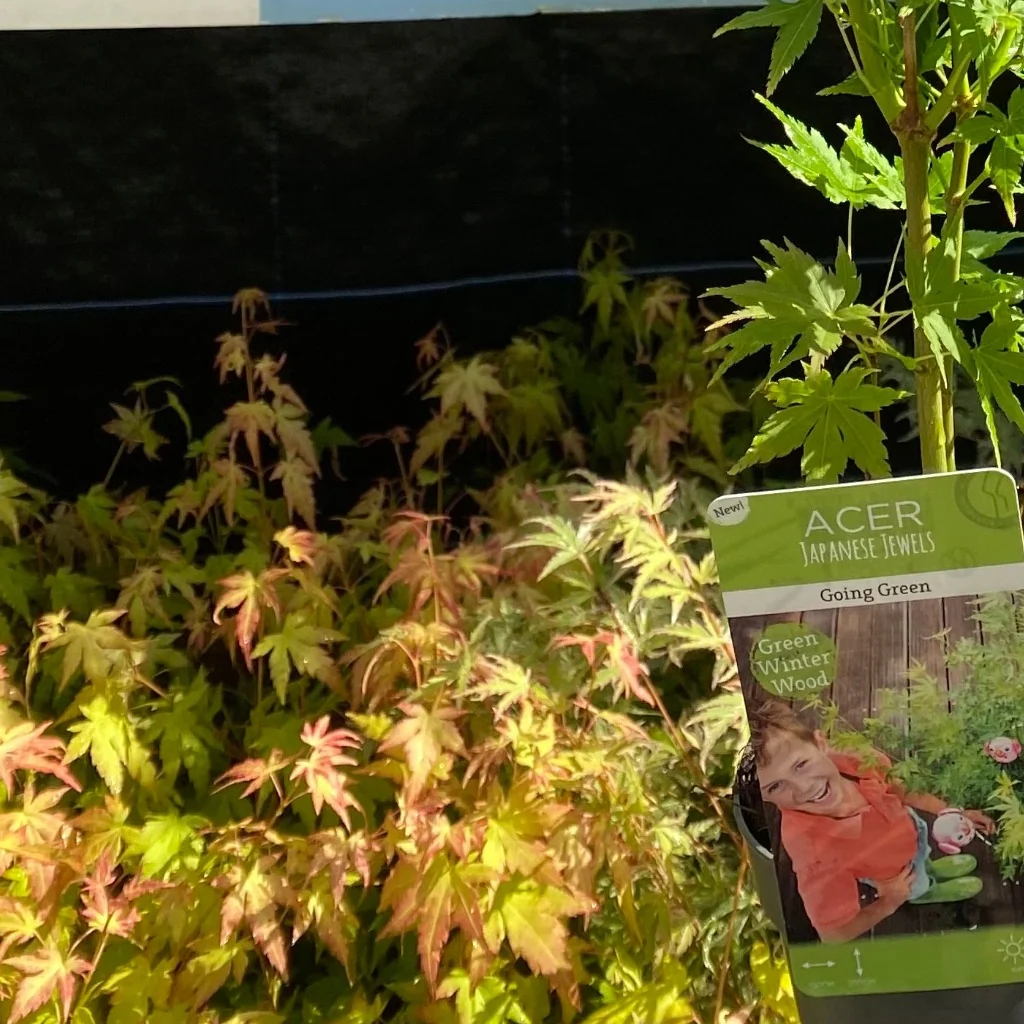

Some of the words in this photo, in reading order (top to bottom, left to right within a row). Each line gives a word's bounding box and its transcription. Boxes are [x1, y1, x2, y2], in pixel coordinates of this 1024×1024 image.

[712, 499, 746, 518] New!
[804, 499, 925, 538] ACER
[800, 535, 878, 568] JAPANESE
[881, 530, 936, 560] JEWELS
[819, 585, 875, 604] Going
[877, 580, 932, 598] Green
[758, 632, 819, 656] Green
[755, 650, 832, 677] Winter
[771, 670, 830, 697] Wood
